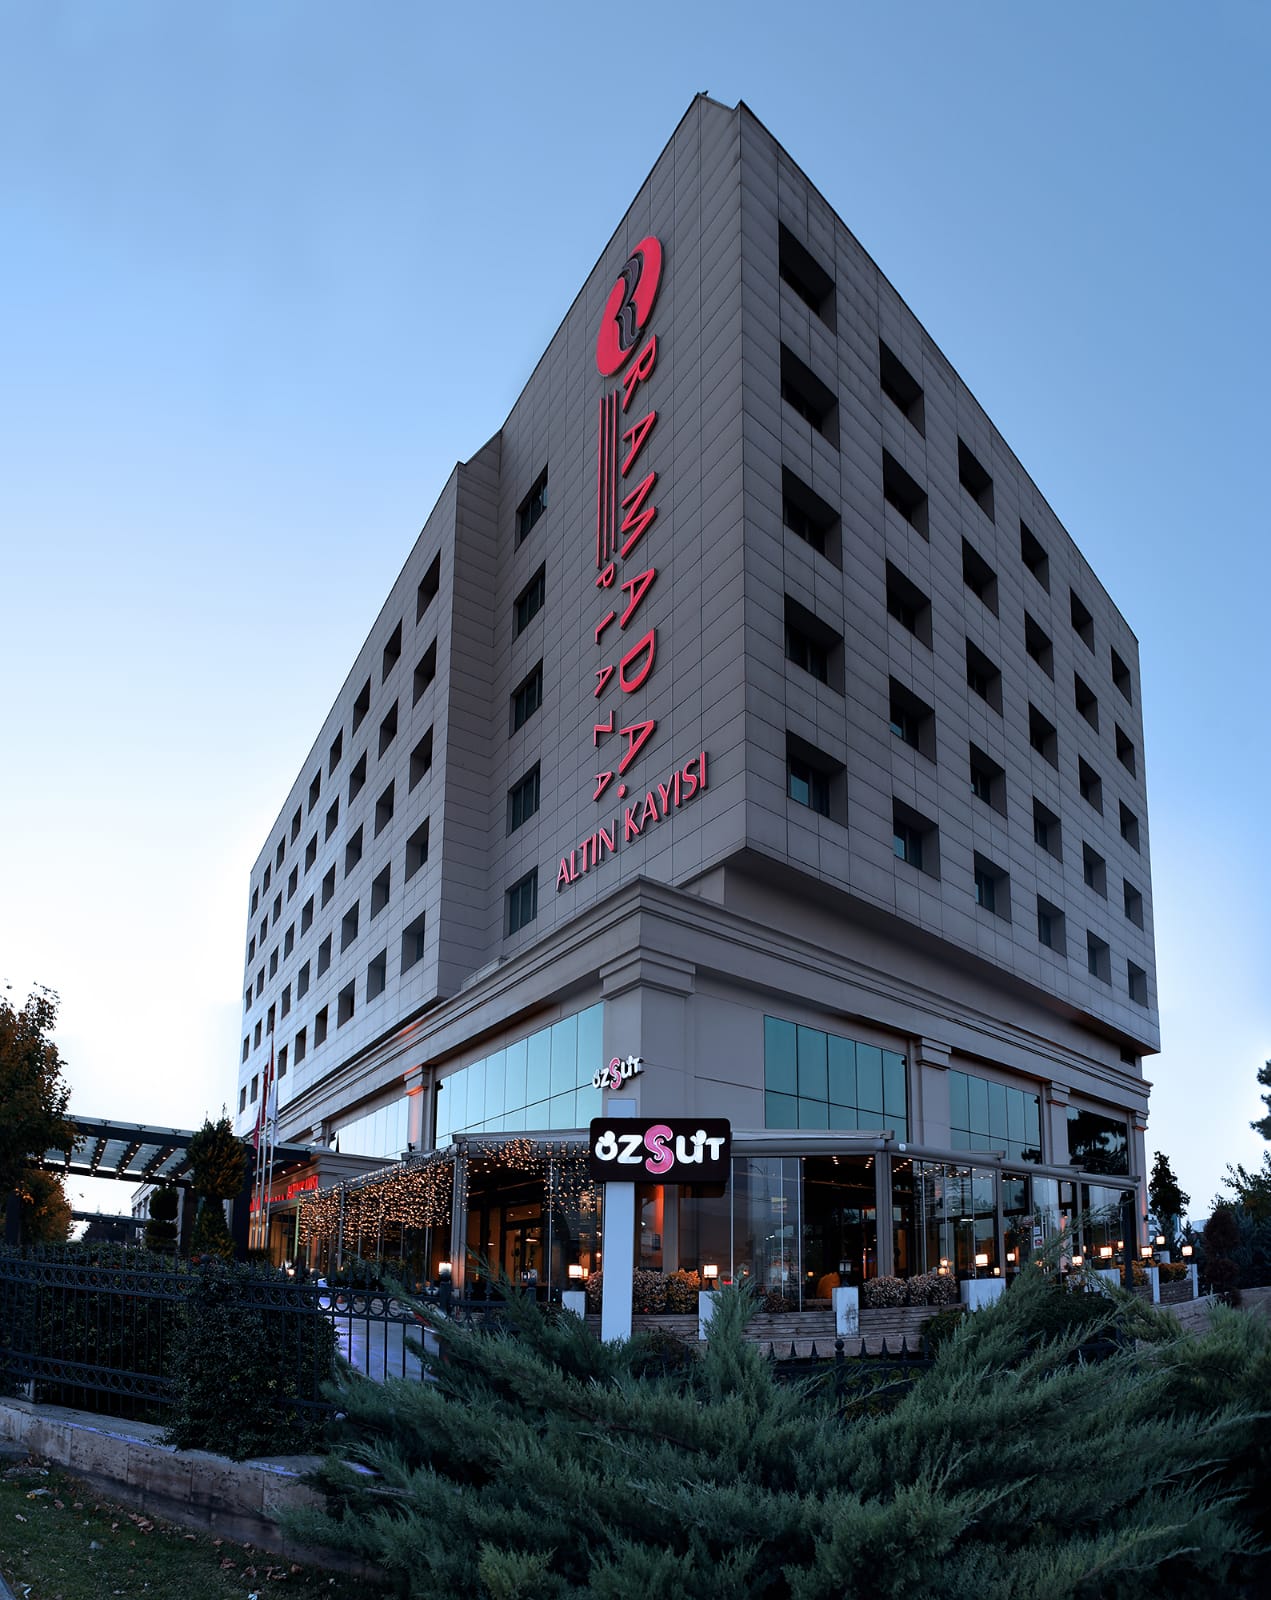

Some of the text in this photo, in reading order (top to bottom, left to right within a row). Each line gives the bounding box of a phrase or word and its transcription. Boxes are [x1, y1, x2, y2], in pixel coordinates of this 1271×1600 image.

[593, 562, 615, 801] PLAZA
[556, 751, 707, 892] ALTIN KAYISI
